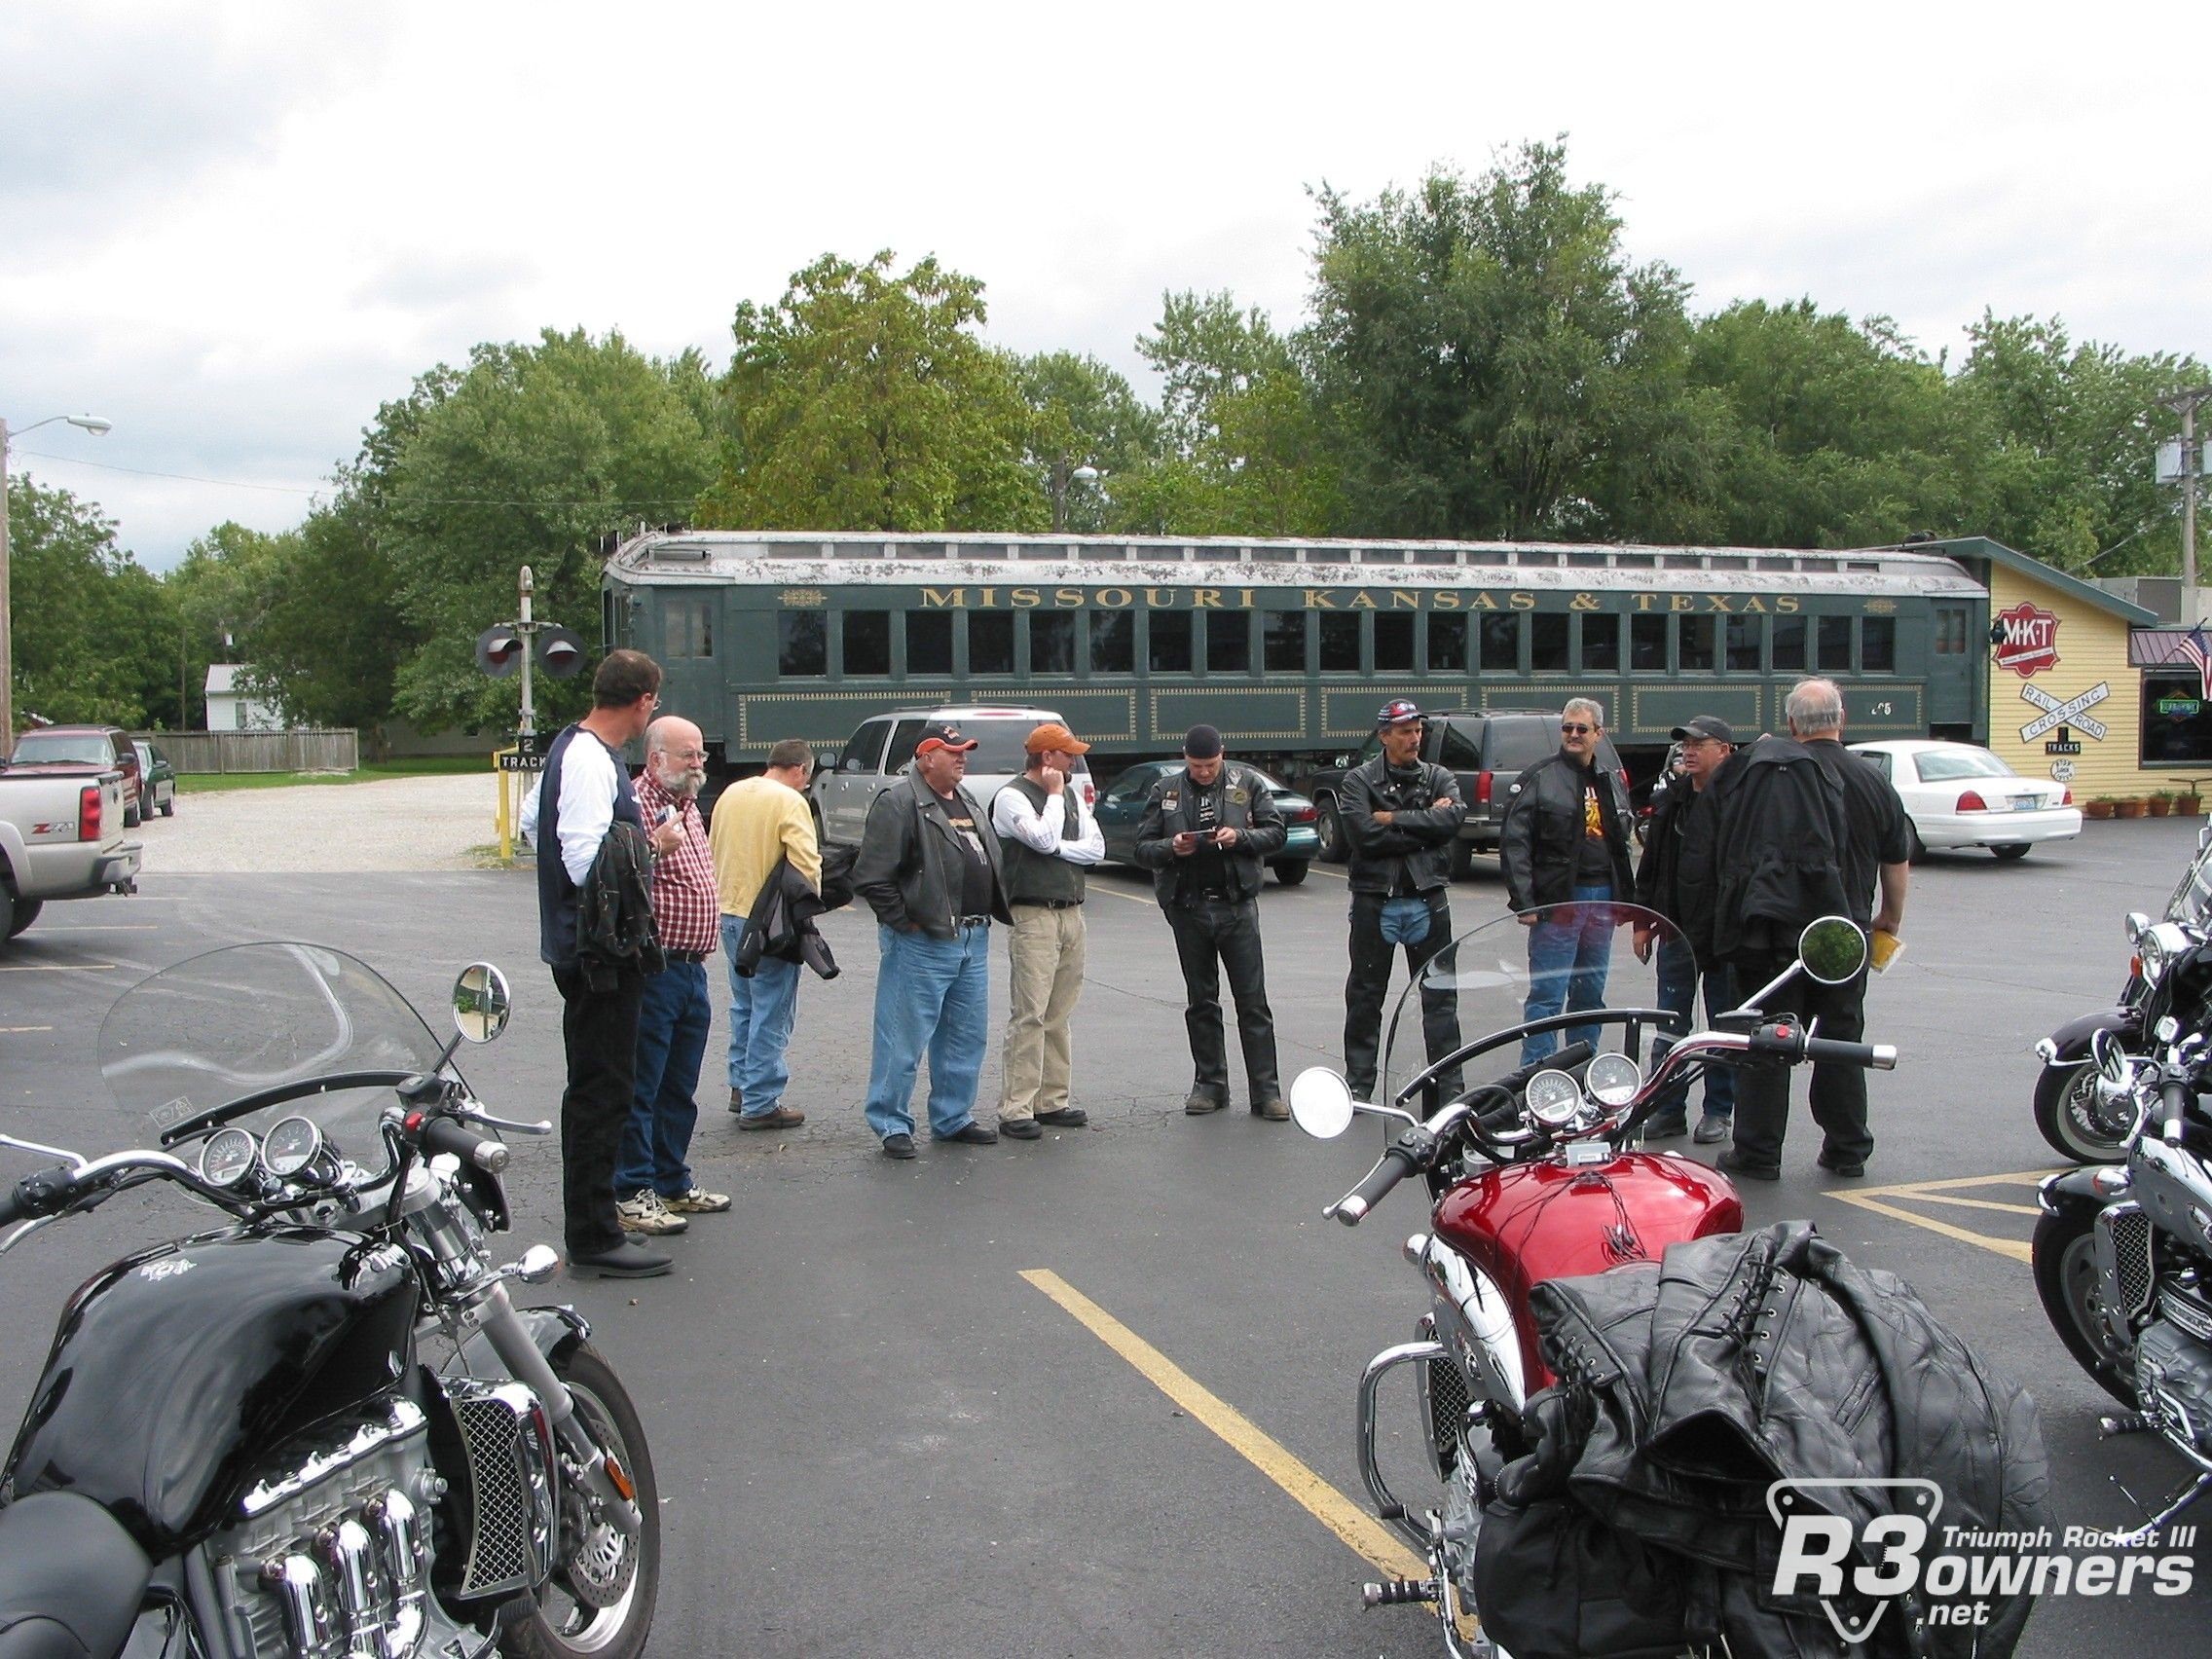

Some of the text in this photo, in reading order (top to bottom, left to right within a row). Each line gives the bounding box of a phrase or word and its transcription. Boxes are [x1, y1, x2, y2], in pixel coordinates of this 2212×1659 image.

[919, 588, 1799, 613] MISSOURI KANSAS & TEXAS
[2025, 687, 2051, 711] RAIL
[2029, 689, 2100, 735] CROSSING
[2075, 714, 2103, 737] ROAD
[523, 739, 535, 753] 2
[2047, 743, 2080, 753] TRACKS
[502, 756, 546, 767] TRACK
